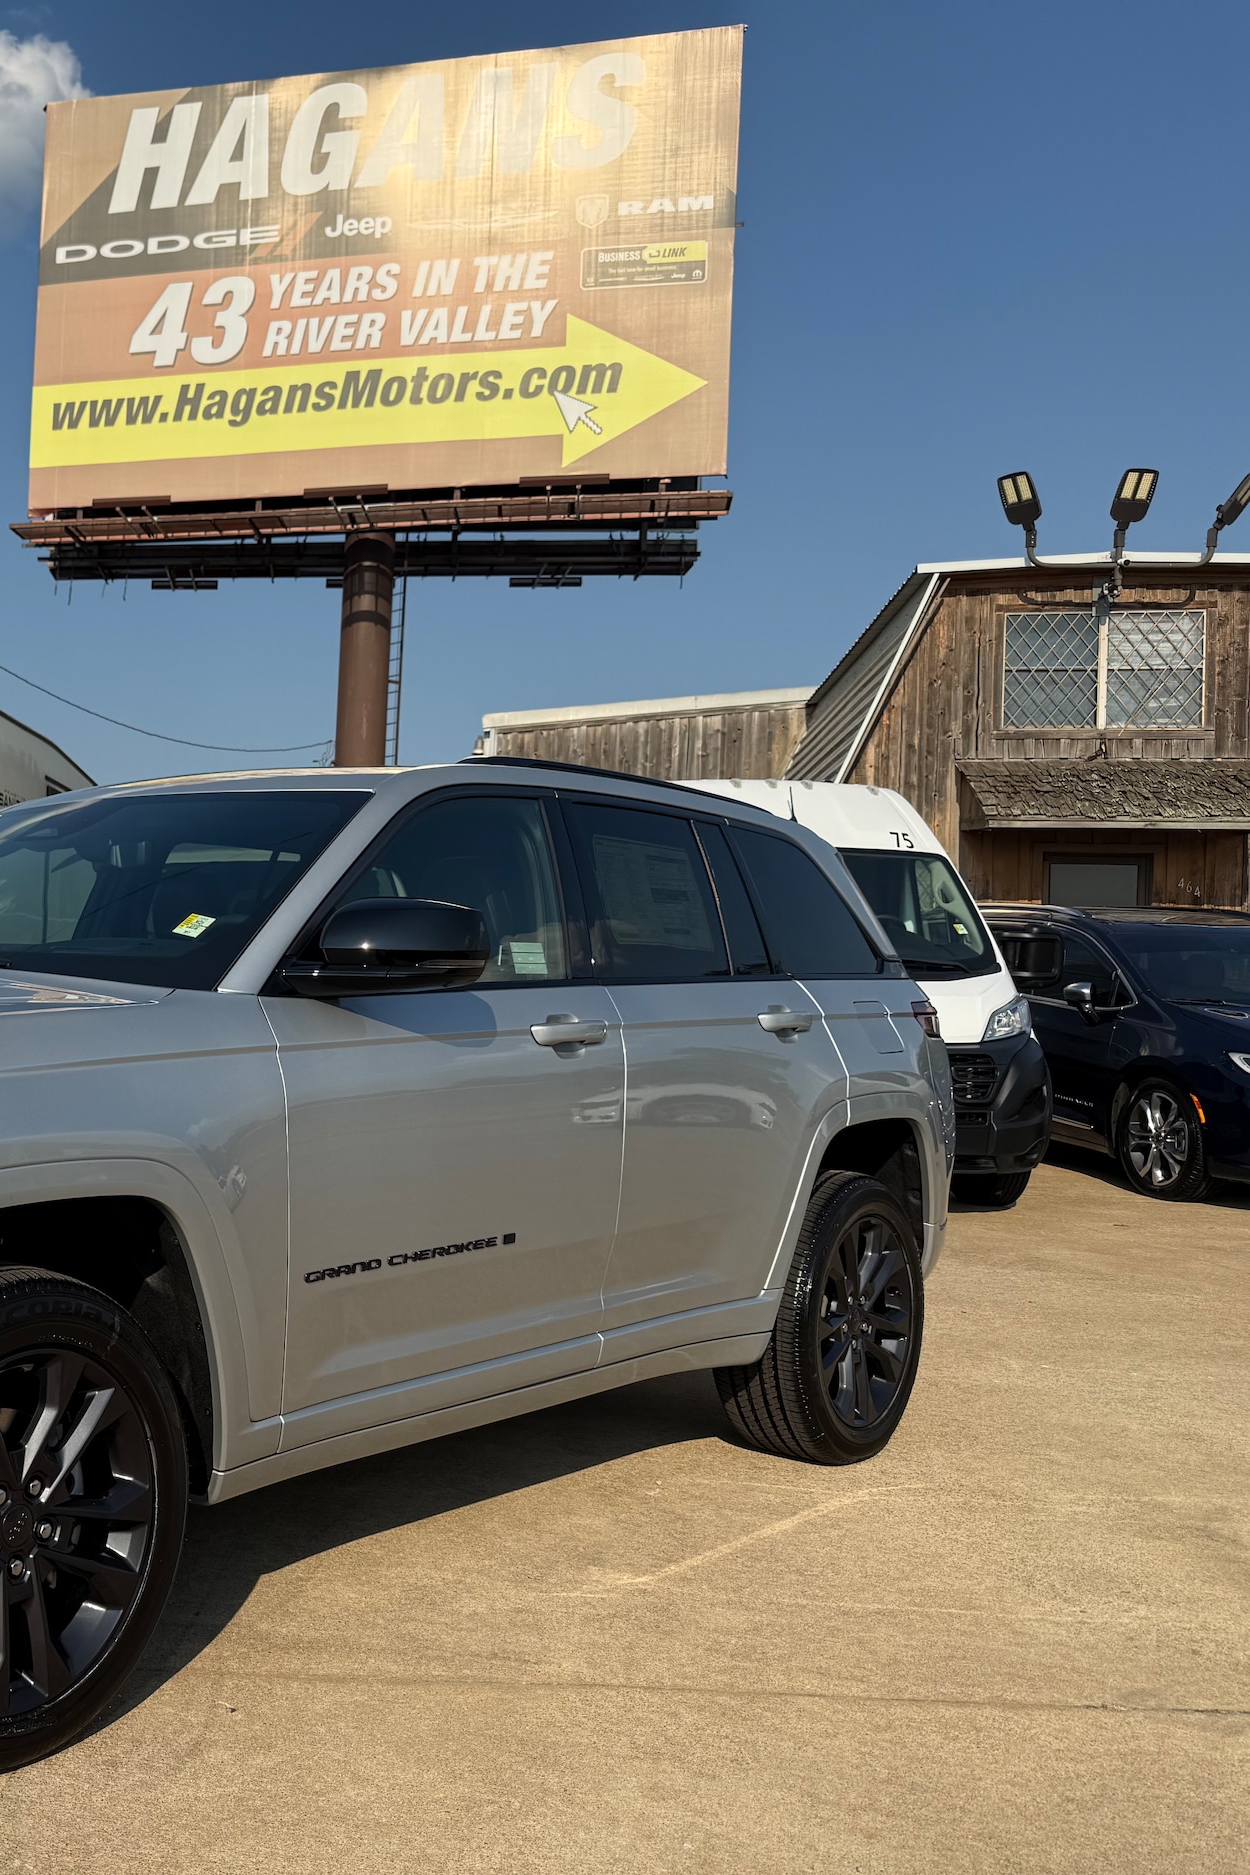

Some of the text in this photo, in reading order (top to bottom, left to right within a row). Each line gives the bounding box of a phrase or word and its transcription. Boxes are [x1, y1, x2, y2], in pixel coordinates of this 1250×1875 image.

[108, 52, 647, 214] HAGANS
[324, 214, 393, 239] Jeep
[617, 195, 715, 216] RAM
[55, 224, 281, 264] DODGE
[598, 247, 688, 262] BUSINESS LINK
[268, 250, 556, 310] YEARS IN THE
[128, 274, 256, 368] 43
[261, 298, 560, 358] RIVER VALLEY
[50, 361, 624, 431] www.HagansMotors.com
[889, 831, 915, 849] 75
[1177, 877, 1201, 898] 464
[303, 1236, 499, 1284] GRAND CHEROKEE
